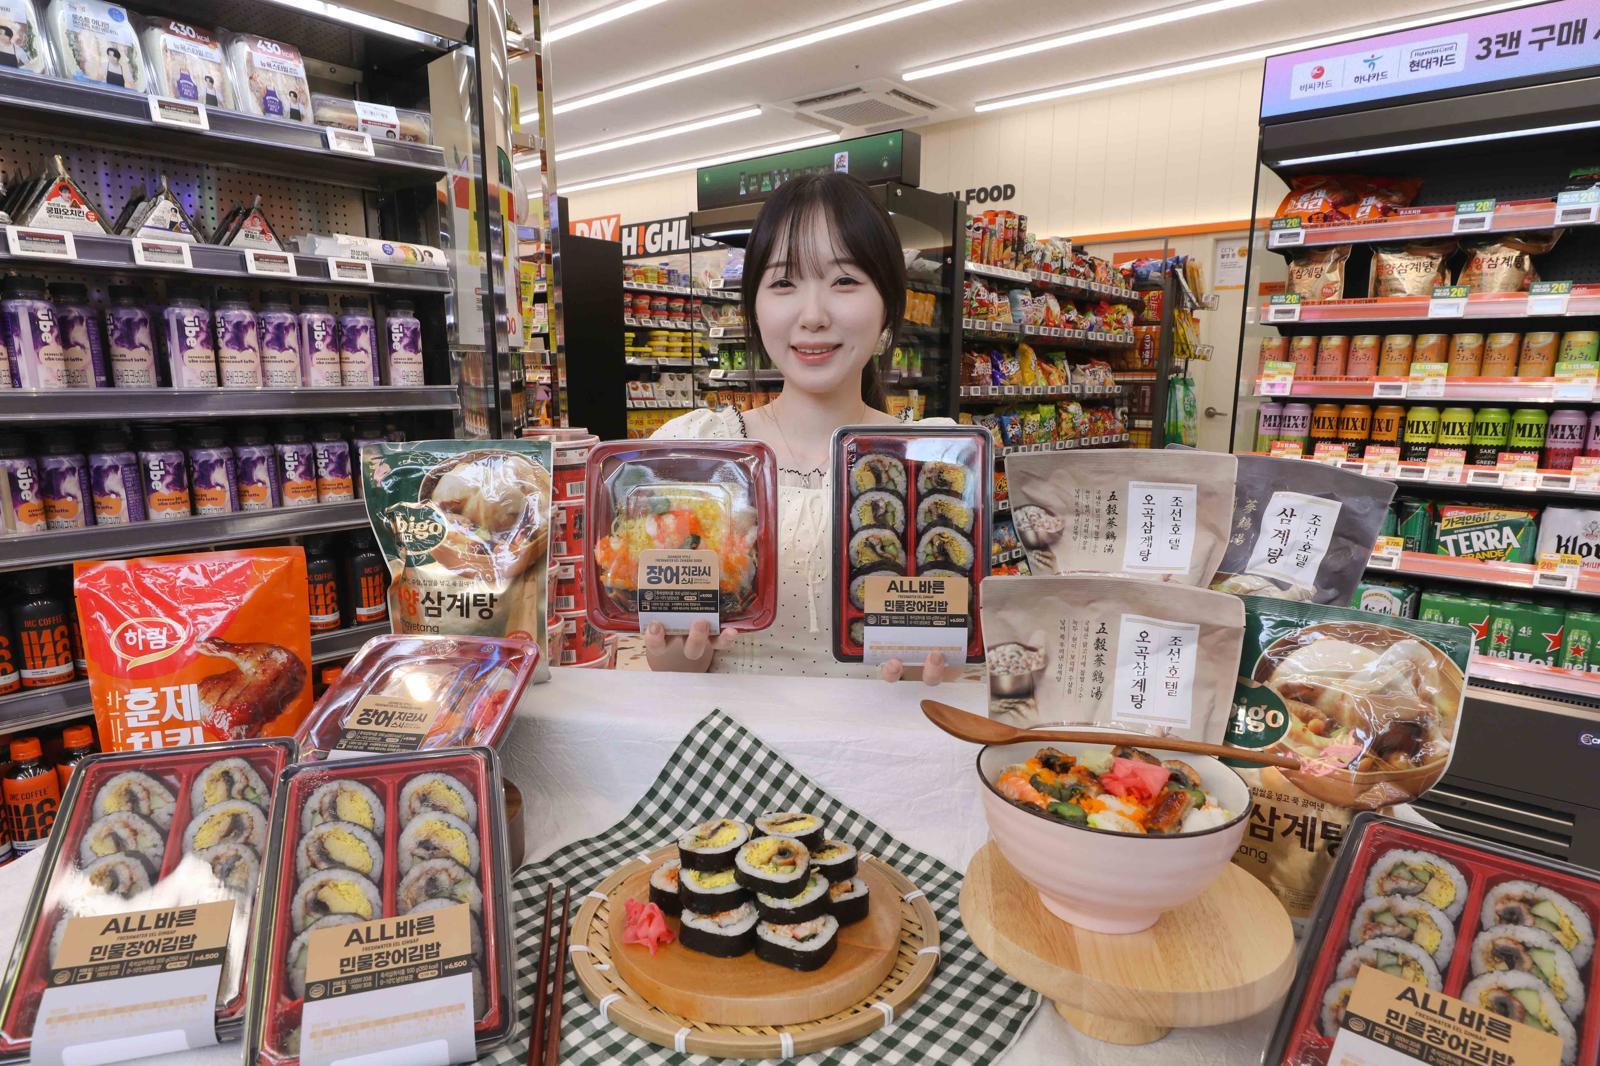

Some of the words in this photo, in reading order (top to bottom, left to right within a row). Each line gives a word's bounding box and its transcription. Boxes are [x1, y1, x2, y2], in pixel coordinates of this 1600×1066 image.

[169, 21, 196, 39] 430
[1475, 30, 1522, 61] 3캔
[1528, 18, 1588, 52] 구매
[256, 39, 281, 53] 430
[1353, 71, 1389, 85] 하나카드
[1409, 55, 1457, 73] 현대카드
[1299, 80, 1333, 92] 비씨카드
[965, 184, 1016, 206] FOOD
[576, 216, 618, 241] DAY
[1139, 494, 1156, 562] 오곡삼계탕
[1168, 496, 1184, 551] 조선호텔
[1267, 507, 1297, 565] 삼계탕
[1296, 513, 1322, 568] 조선호텔
[1439, 526, 1520, 557] TERRA
[646, 565, 680, 585] 장어
[681, 566, 711, 577] 지라시
[887, 580, 945, 594] ALL바른
[884, 600, 948, 613] 민물장어김밥
[124, 626, 168, 651] 하림
[1130, 630, 1151, 710] 오곡삼계탕
[1165, 635, 1184, 697] 조선호텔
[124, 683, 201, 728] 훈제
[356, 708, 397, 727] 장어
[394, 711, 428, 723] 지라시
[99, 908, 197, 936] ALL바른
[344, 915, 436, 947] ALL바른
[88, 934, 198, 963] 민물장어김밥
[339, 942, 442, 974] 민물장어김밥
